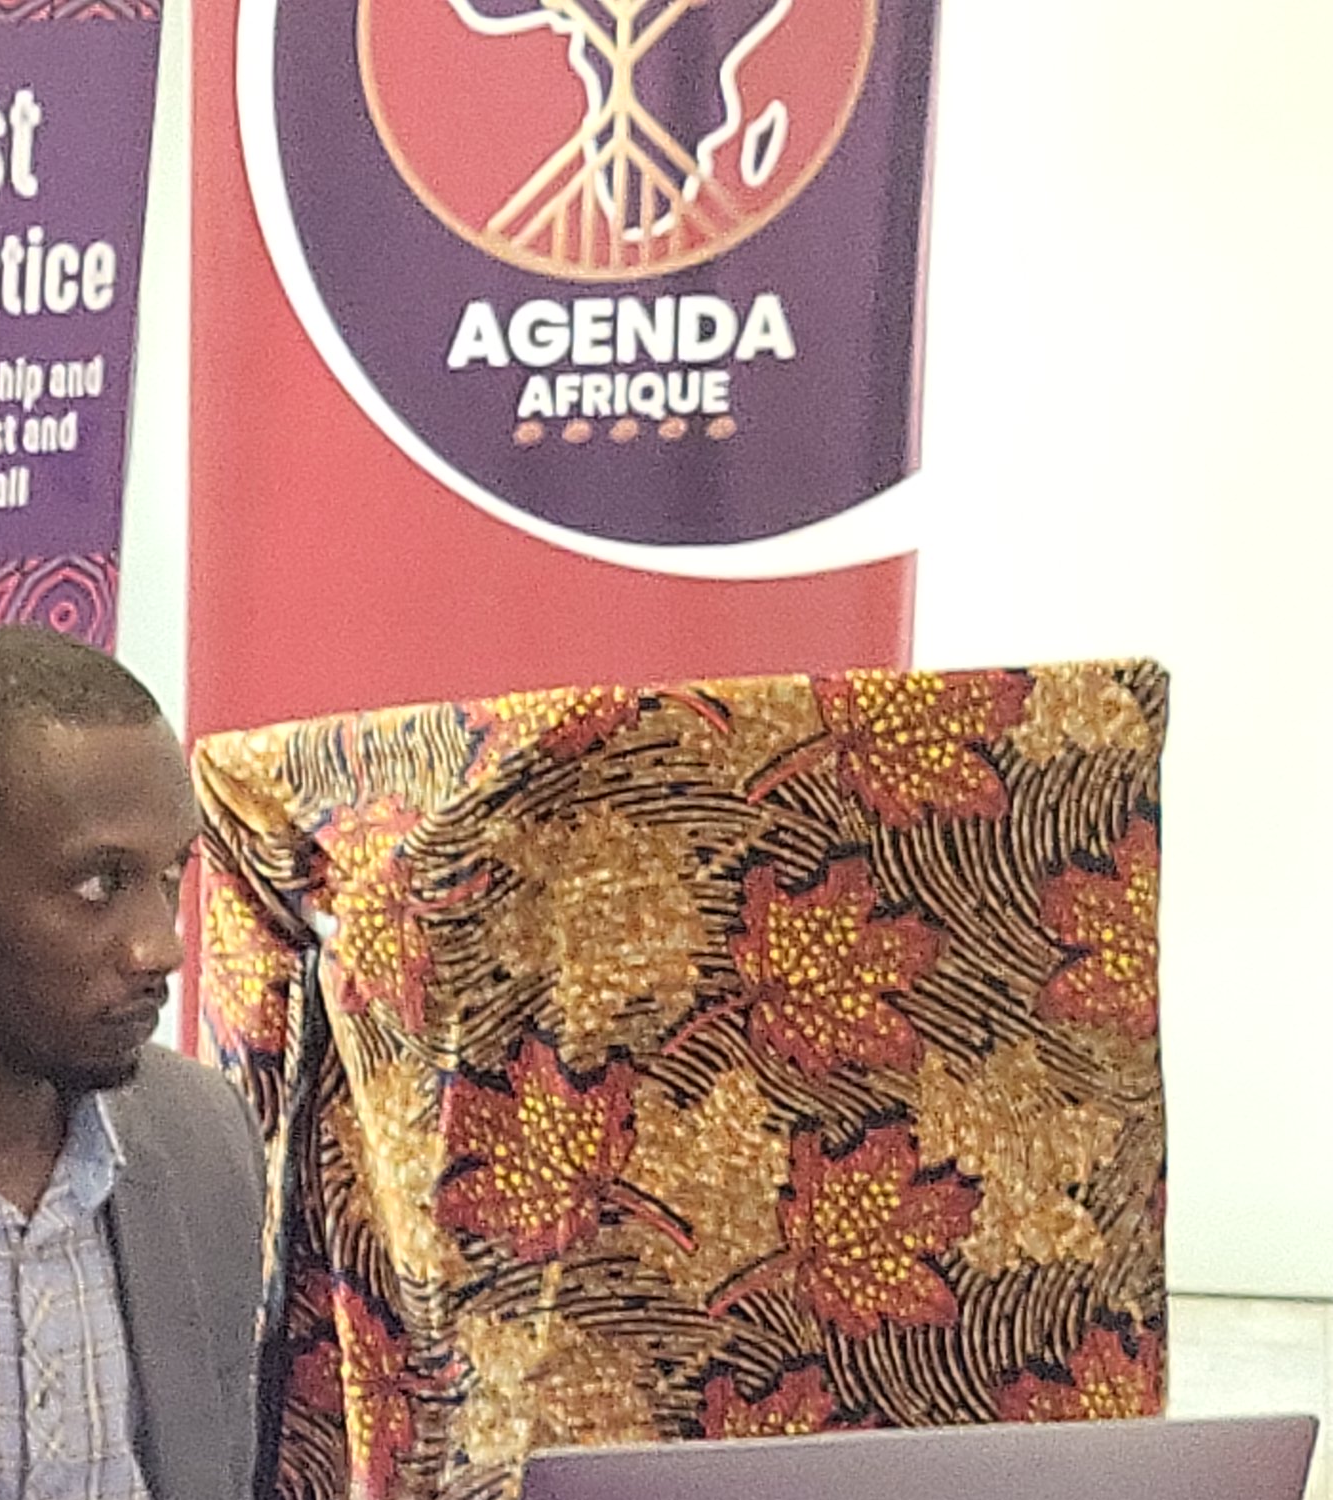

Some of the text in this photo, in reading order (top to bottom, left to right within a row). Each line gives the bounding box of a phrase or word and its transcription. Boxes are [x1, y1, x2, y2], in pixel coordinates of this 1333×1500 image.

[447, 294, 796, 369] AGENDA
[48, 354, 103, 398] and
[517, 370, 730, 418] AFRIQUE
[22, 411, 77, 453] and
